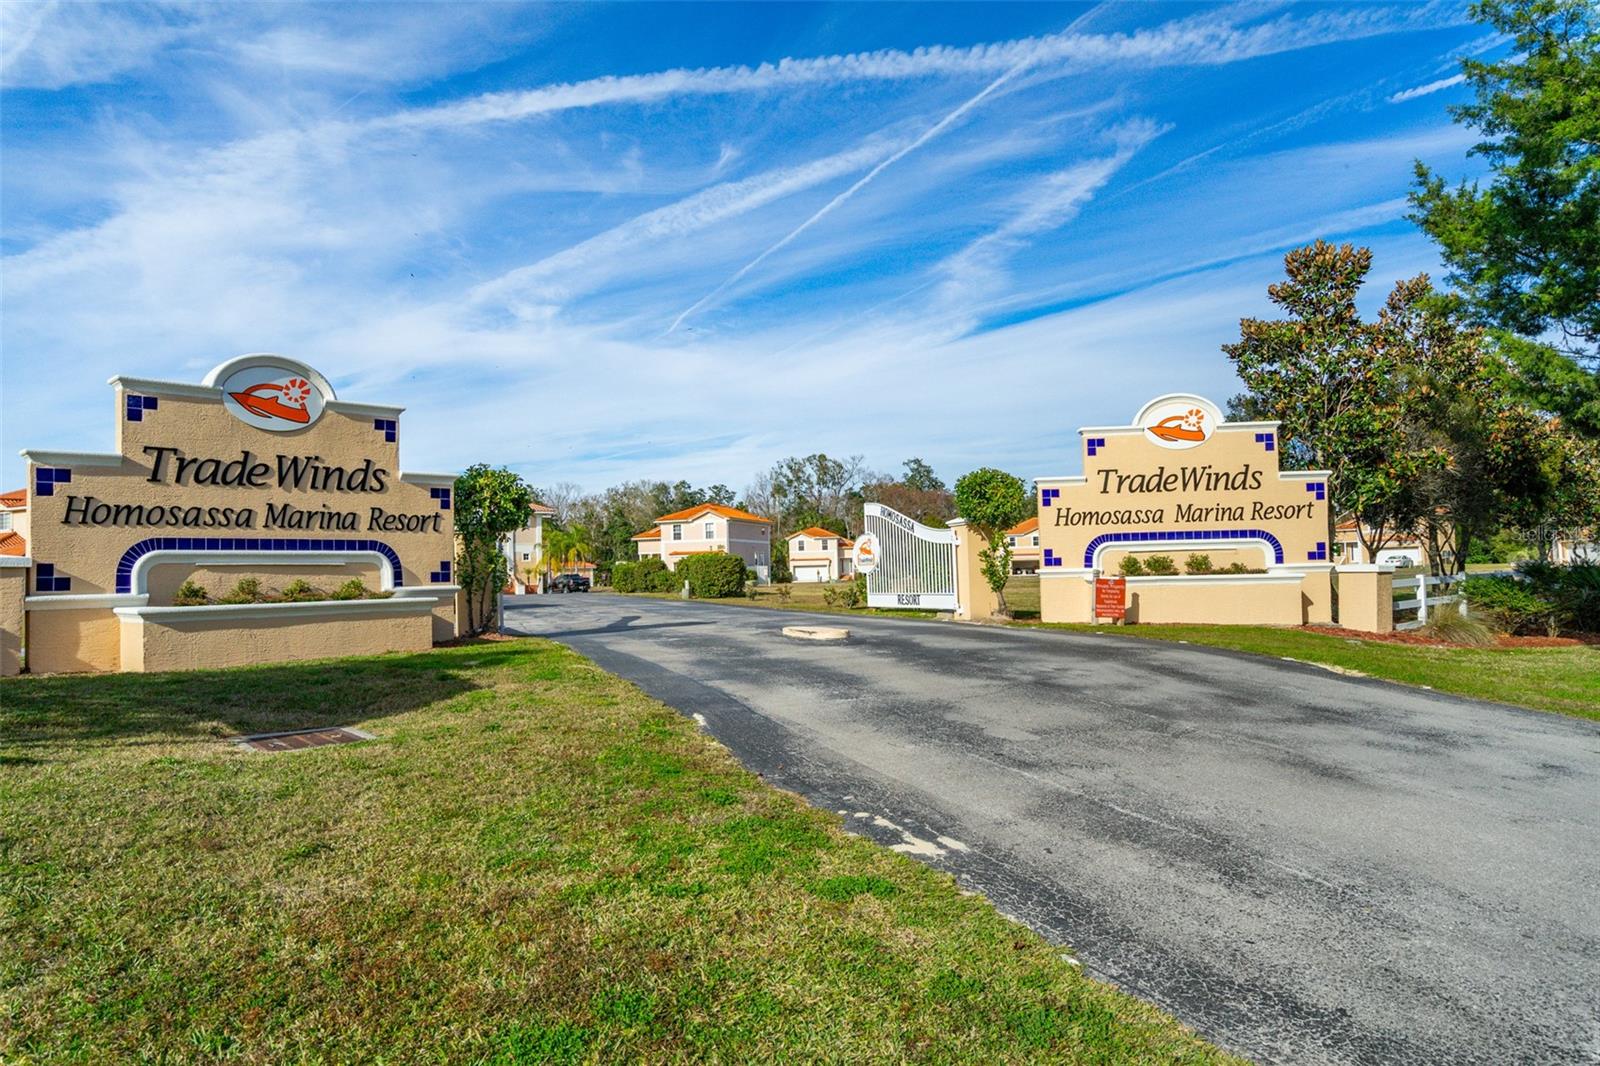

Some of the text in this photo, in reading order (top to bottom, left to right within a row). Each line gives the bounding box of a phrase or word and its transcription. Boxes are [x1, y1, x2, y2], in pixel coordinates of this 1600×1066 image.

[142, 446, 387, 493] TradeWinds
[1096, 464, 1263, 494] TradeWinds
[61, 495, 441, 533] Homosassa Marina Resort
[880, 506, 915, 533] HOMOSASSA
[1054, 501, 1315, 527] Homosassa Marina Resort
[897, 594, 921, 606] RESORT
